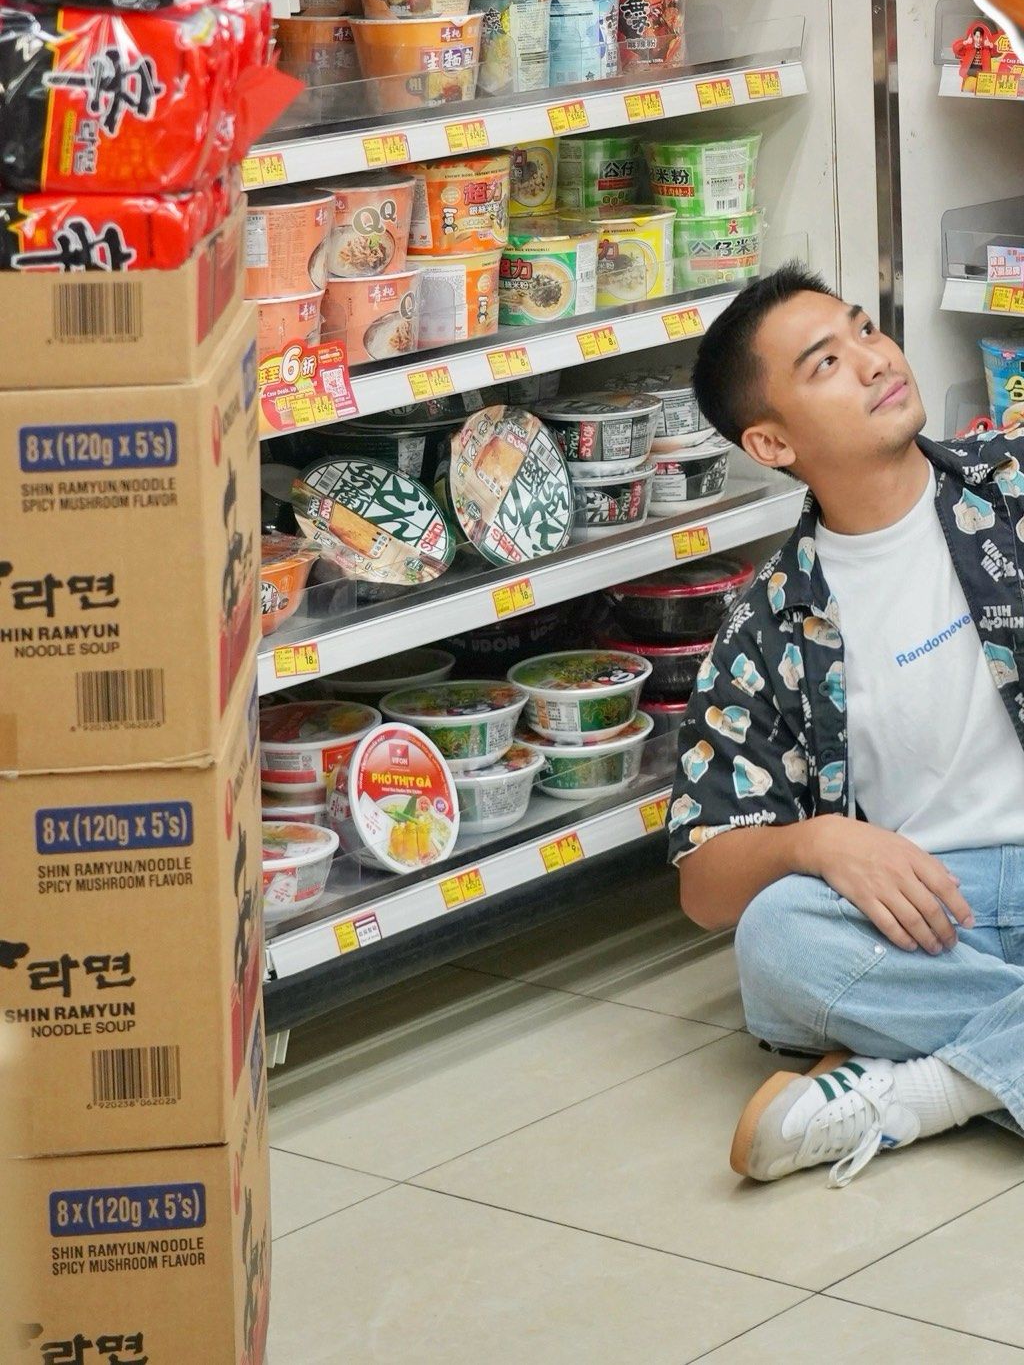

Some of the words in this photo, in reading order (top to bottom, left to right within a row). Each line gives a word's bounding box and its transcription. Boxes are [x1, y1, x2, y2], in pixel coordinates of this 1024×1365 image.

[353, 205, 396, 235] QQ
[21, 482, 54, 496] SHIN
[21, 498, 55, 513] SPICY
[59, 495, 130, 510] MUSHROOM
[134, 493, 178, 508] FLAVOR
[11, 572, 120, 617] 라면
[38, 623, 119, 640] RAMYUN
[15, 643, 77, 658] NOODLE
[80, 641, 120, 656] SOUP
[37, 864, 71, 879] SHIN
[74, 857, 192, 876] RAMYUN/NOODLE
[38, 878, 72, 895] SPICY
[75, 874, 145, 892] MUSHROOM
[148, 872, 193, 889] FLAVOR
[27, 952, 136, 998] 라면
[4, 1006, 50, 1025] SHIN
[54, 1002, 136, 1021] RAMYUN
[31, 1023, 92, 1039] NOODLE
[95, 1019, 136, 1035] SOUP
[51, 1245, 84, 1260] SHIN
[87, 1238, 204, 1257] RAMYUN/NOODLE
[51, 1259, 85, 1276] SPICY
[89, 1255, 158, 1273] MUSHROOM
[161, 1253, 206, 1270] FLAVOR
